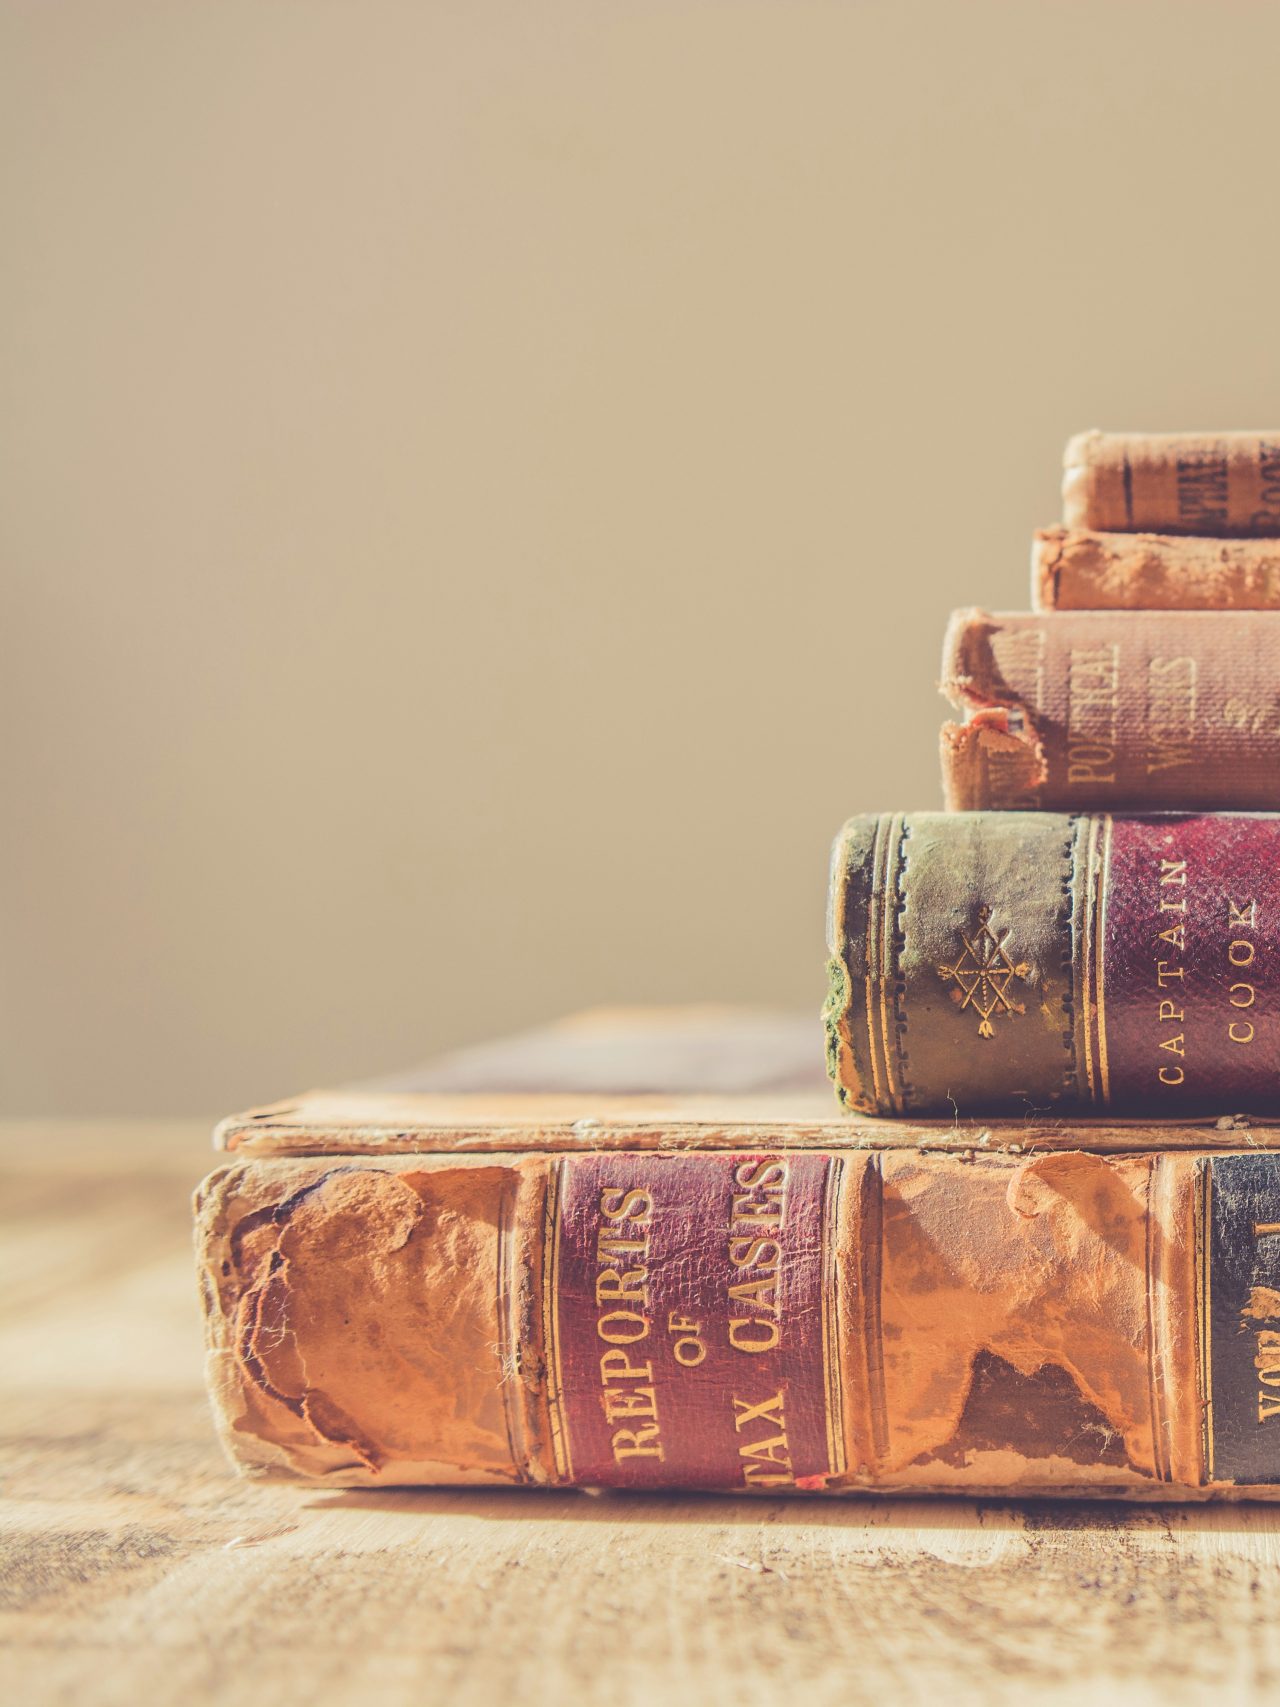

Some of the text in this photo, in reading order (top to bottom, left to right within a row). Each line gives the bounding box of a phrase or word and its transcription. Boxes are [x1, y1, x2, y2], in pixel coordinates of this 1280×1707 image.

[1147, 656, 1197, 774] WORKS
[1158, 858, 1187, 1086] CAPTAIN
[1228, 898, 1256, 1044] COOK
[596, 1186, 665, 1466] REPORTS
[668, 1311, 706, 1367] OF
[728, 1158, 794, 1487] TAX CASES
